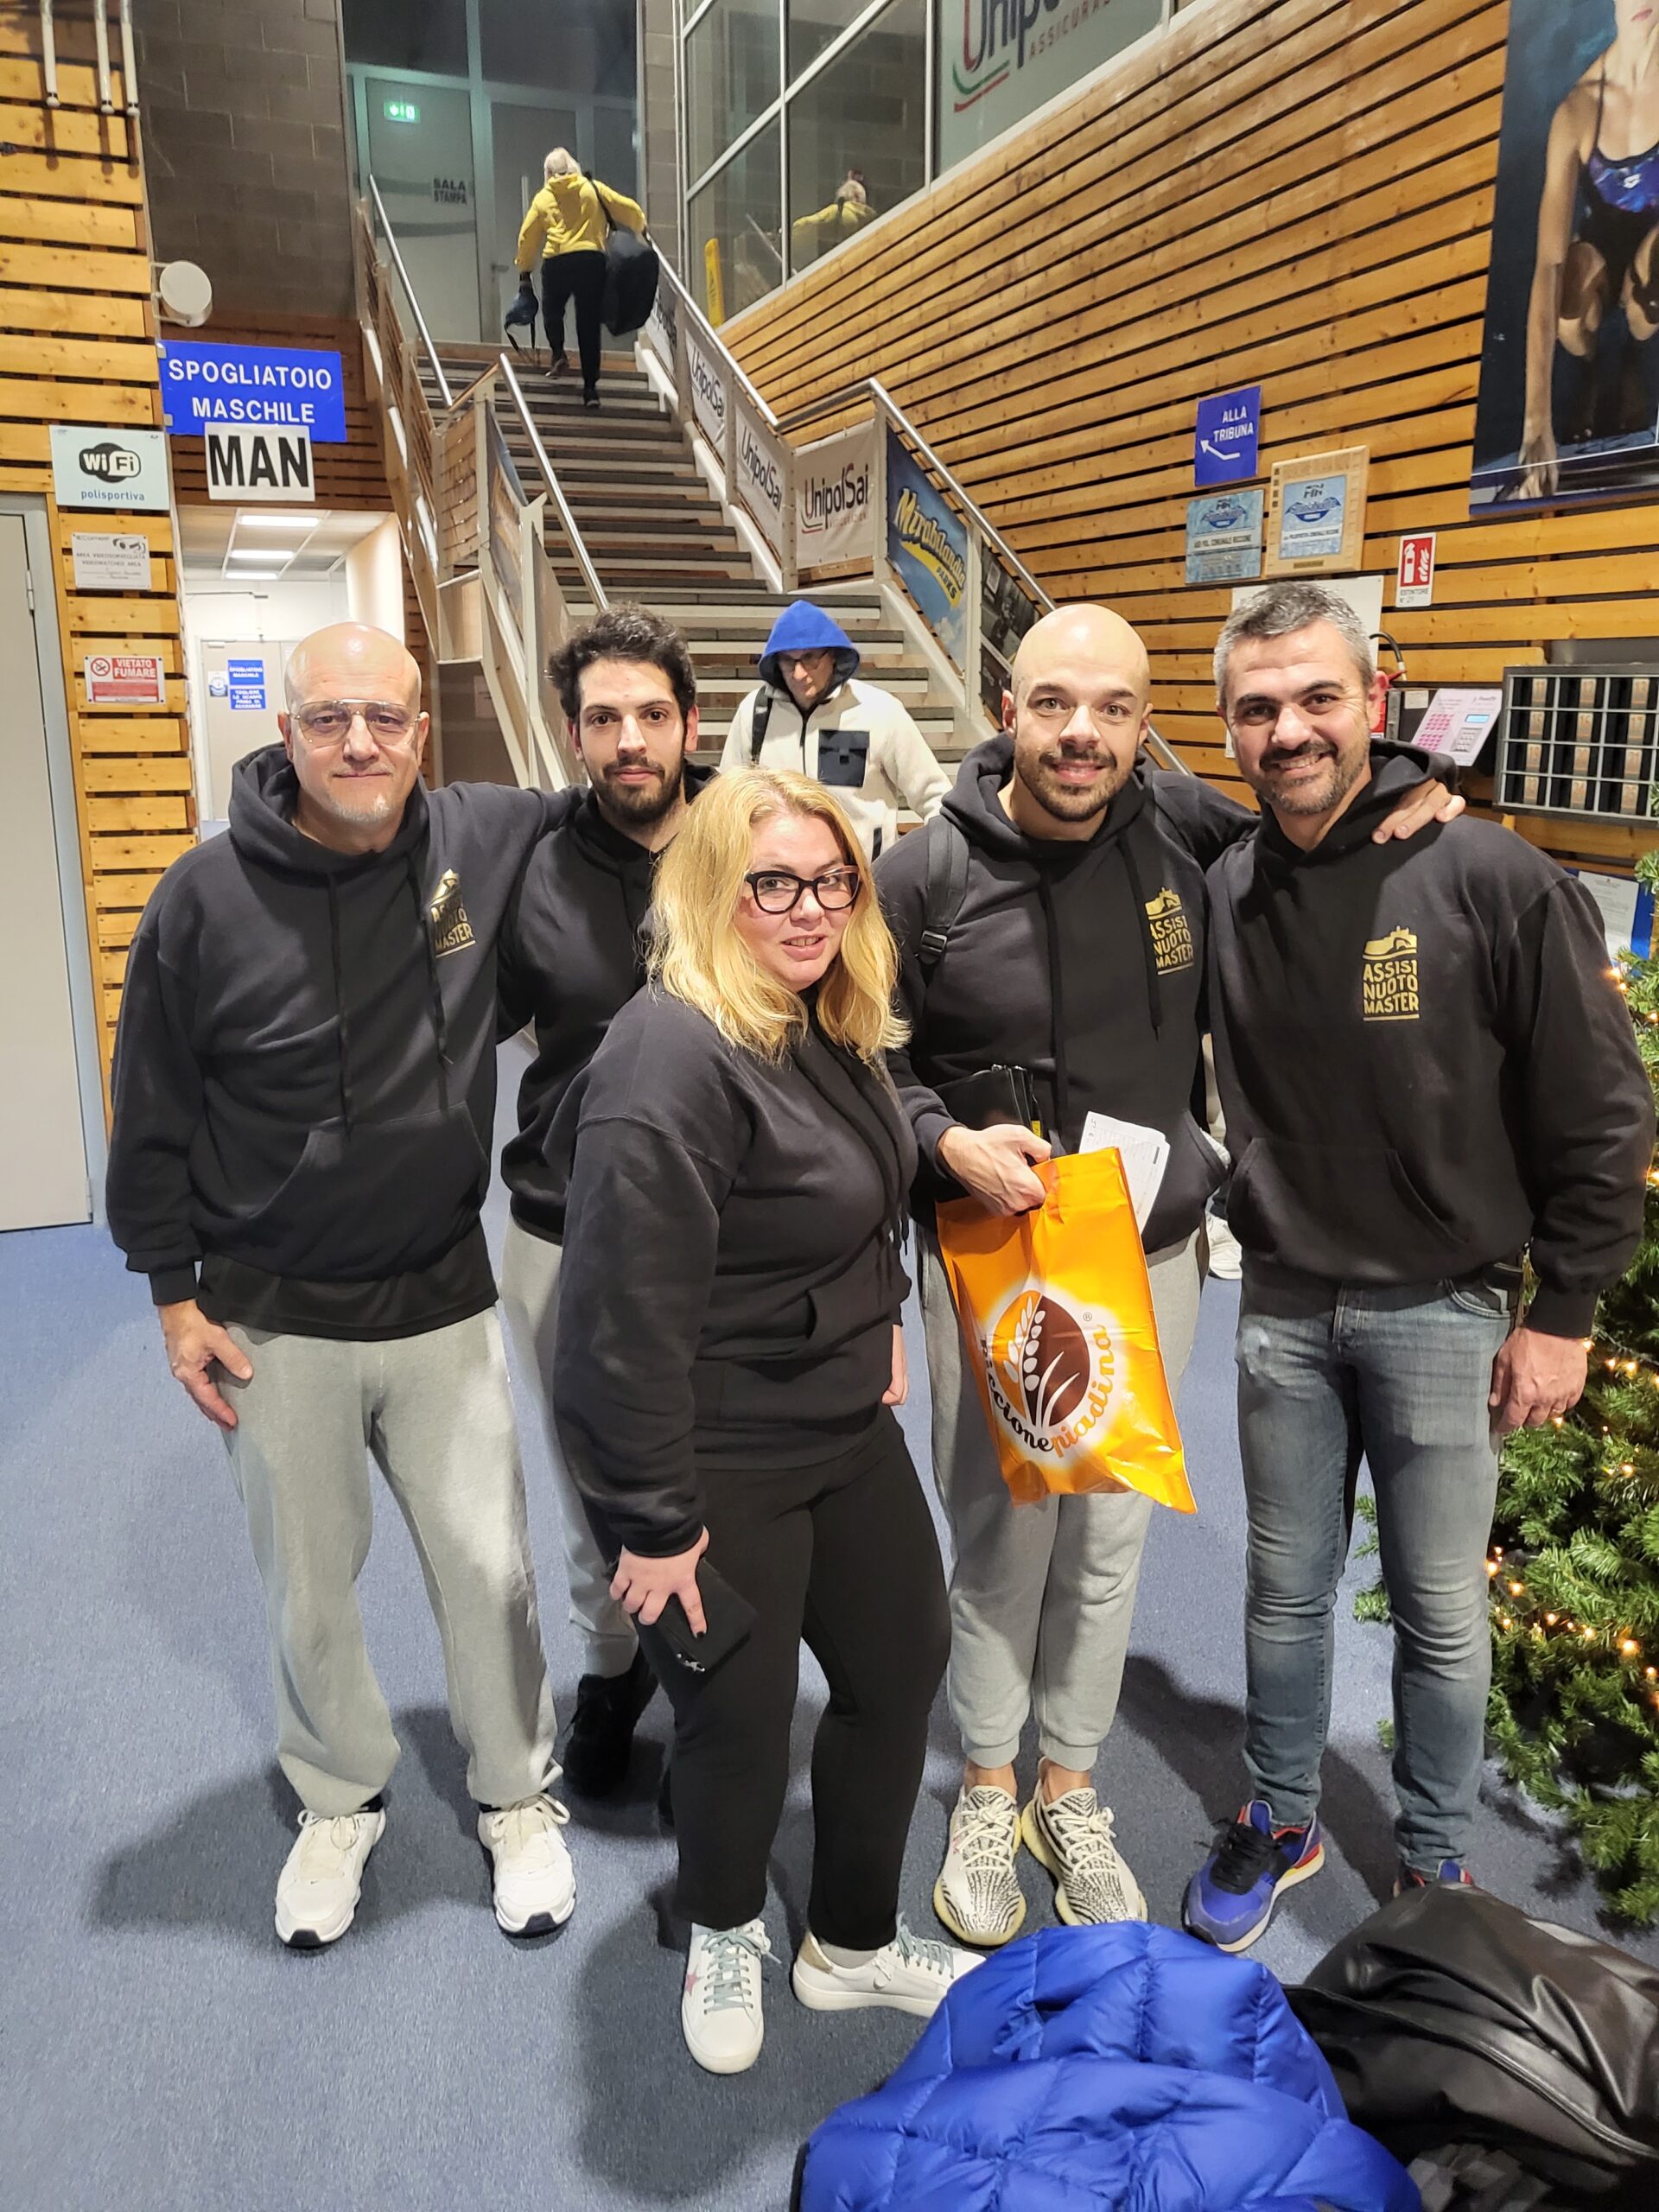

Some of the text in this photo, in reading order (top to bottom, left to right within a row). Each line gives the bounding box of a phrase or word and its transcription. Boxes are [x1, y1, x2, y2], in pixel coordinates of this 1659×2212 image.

[1029, 0, 1110, 58] ASSICURA
[434, 178, 466, 190] SALA
[168, 359, 332, 390] SPOGLIATOIO
[192, 397, 315, 423] MASCHILE
[1222, 406, 1247, 423] ALLA
[1213, 422, 1254, 442] TRIBUNA
[207, 434, 309, 487] MAN
[81, 489, 145, 501] polisportiva
[804, 463, 869, 529] UnipolSai
[893, 487, 966, 589] Mirabilandia
[936, 566, 957, 599] PARKS
[113, 668, 156, 677] FUMARE
[116, 658, 152, 668] VIETATO
[430, 895, 464, 923] ASI
[435, 923, 474, 951] MASTER
[1155, 944, 1193, 969] MASTER
[1363, 960, 1417, 982] ASSISI
[1363, 974, 1418, 1000] NUOTO
[1363, 992, 1419, 1014] MASTER
[1051, 1324, 1116, 1459] piadina
